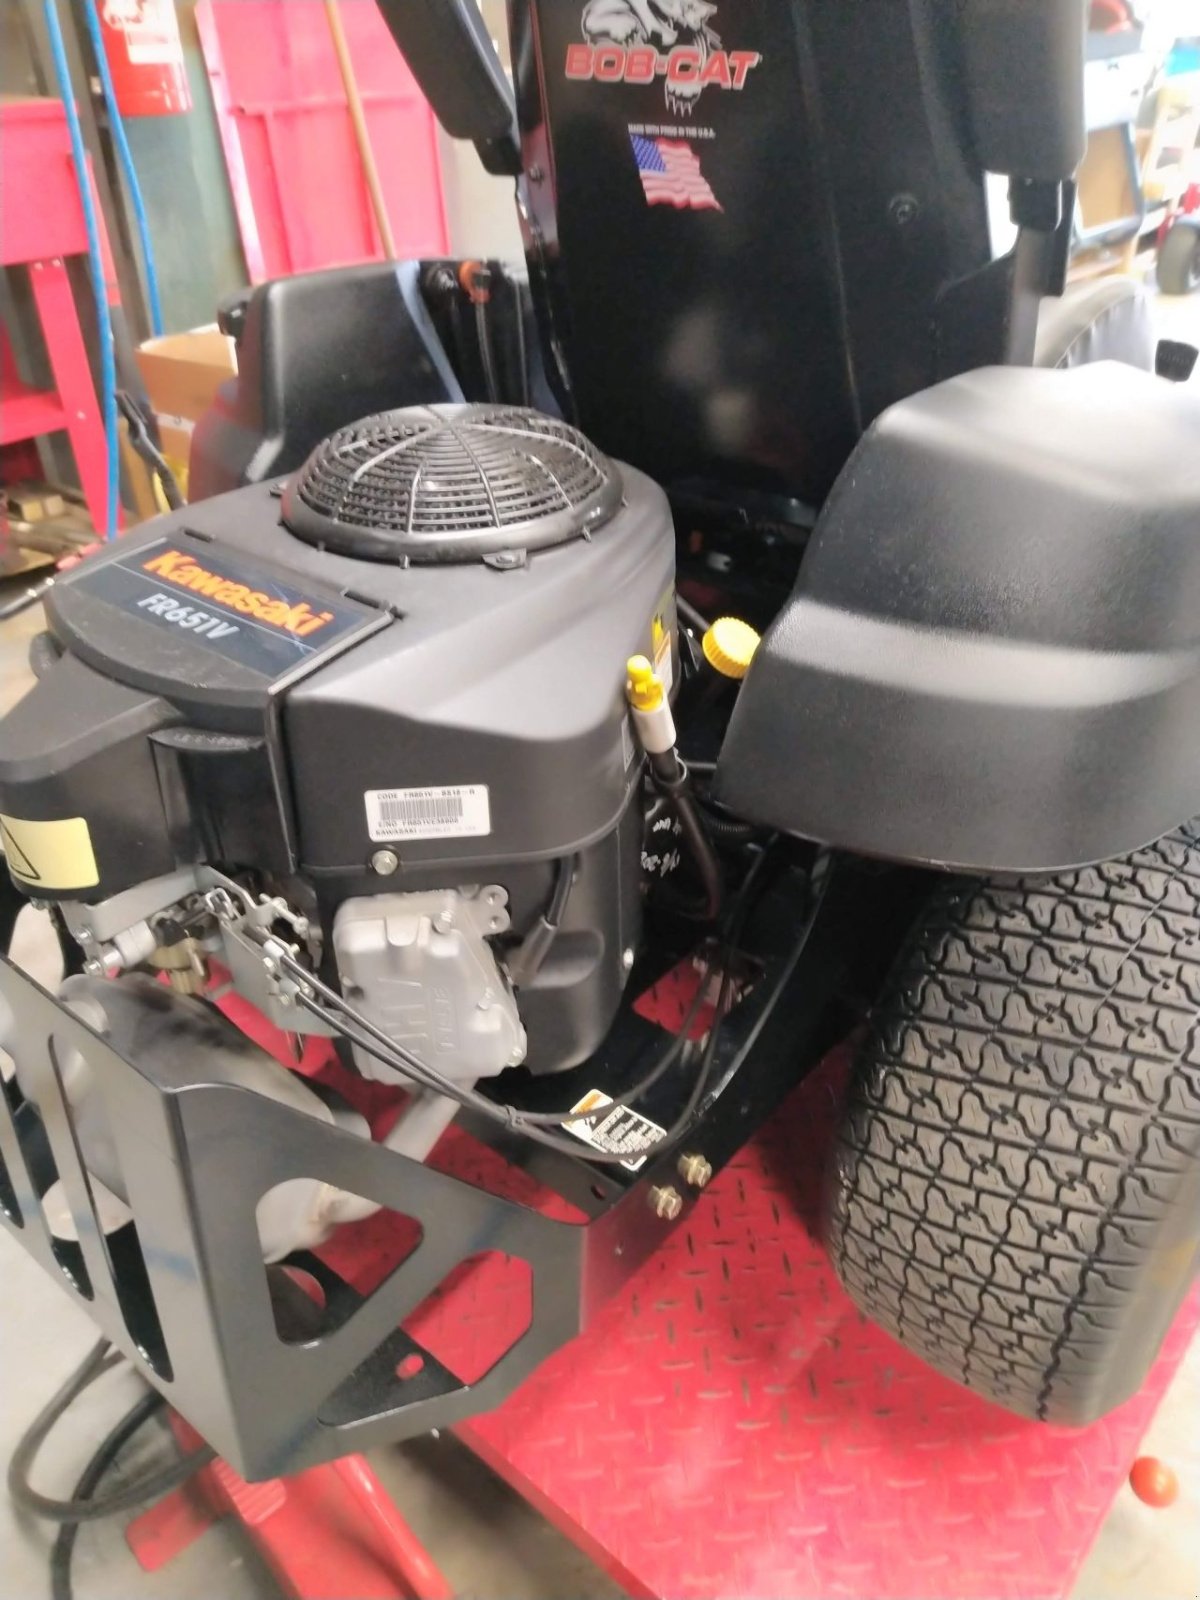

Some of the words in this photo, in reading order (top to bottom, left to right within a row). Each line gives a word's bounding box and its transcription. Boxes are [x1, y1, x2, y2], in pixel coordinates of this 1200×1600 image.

[565, 44, 759, 90] BOB-CAT
[136, 592, 241, 640] FR651V
[142, 550, 336, 637] Kawasaki
